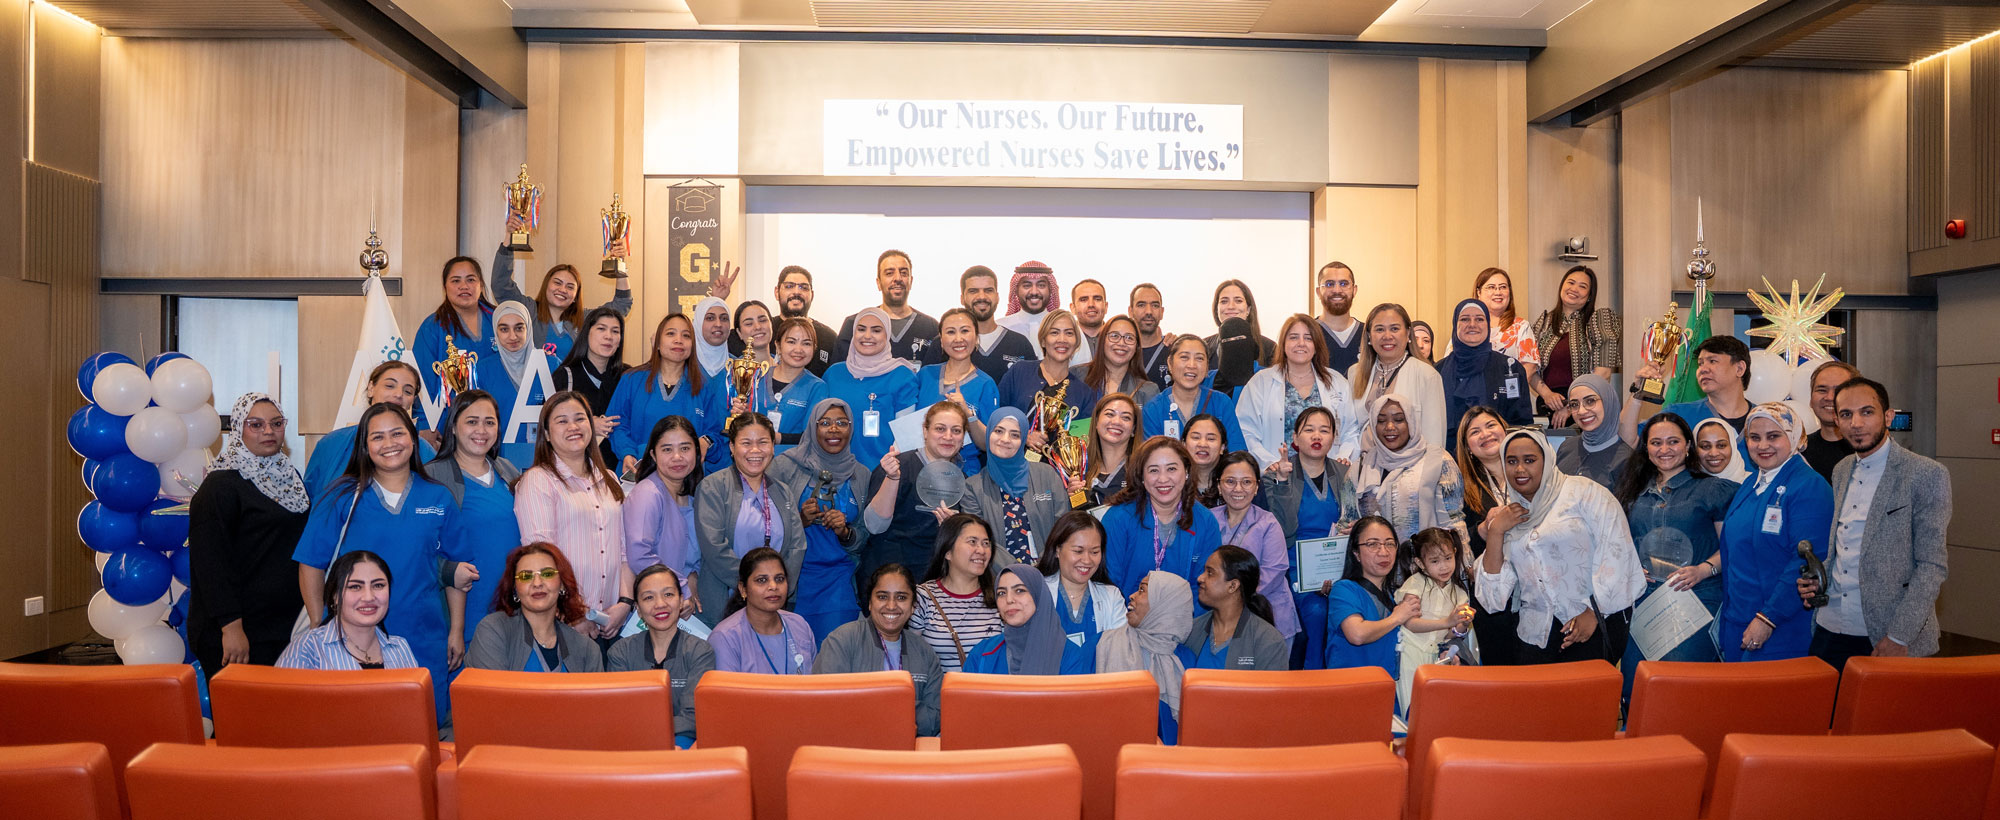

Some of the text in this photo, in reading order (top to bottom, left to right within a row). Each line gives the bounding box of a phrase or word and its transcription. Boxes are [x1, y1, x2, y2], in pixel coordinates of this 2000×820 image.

[898, 102, 948, 129] Our
[956, 102, 1049, 129] Nurses.
[1057, 103, 1107, 130] Our
[1115, 105, 1204, 133] Future.
[847, 139, 1239, 175] Empowered Nurses Save Lives.”
[671, 216, 719, 236] Congrats
